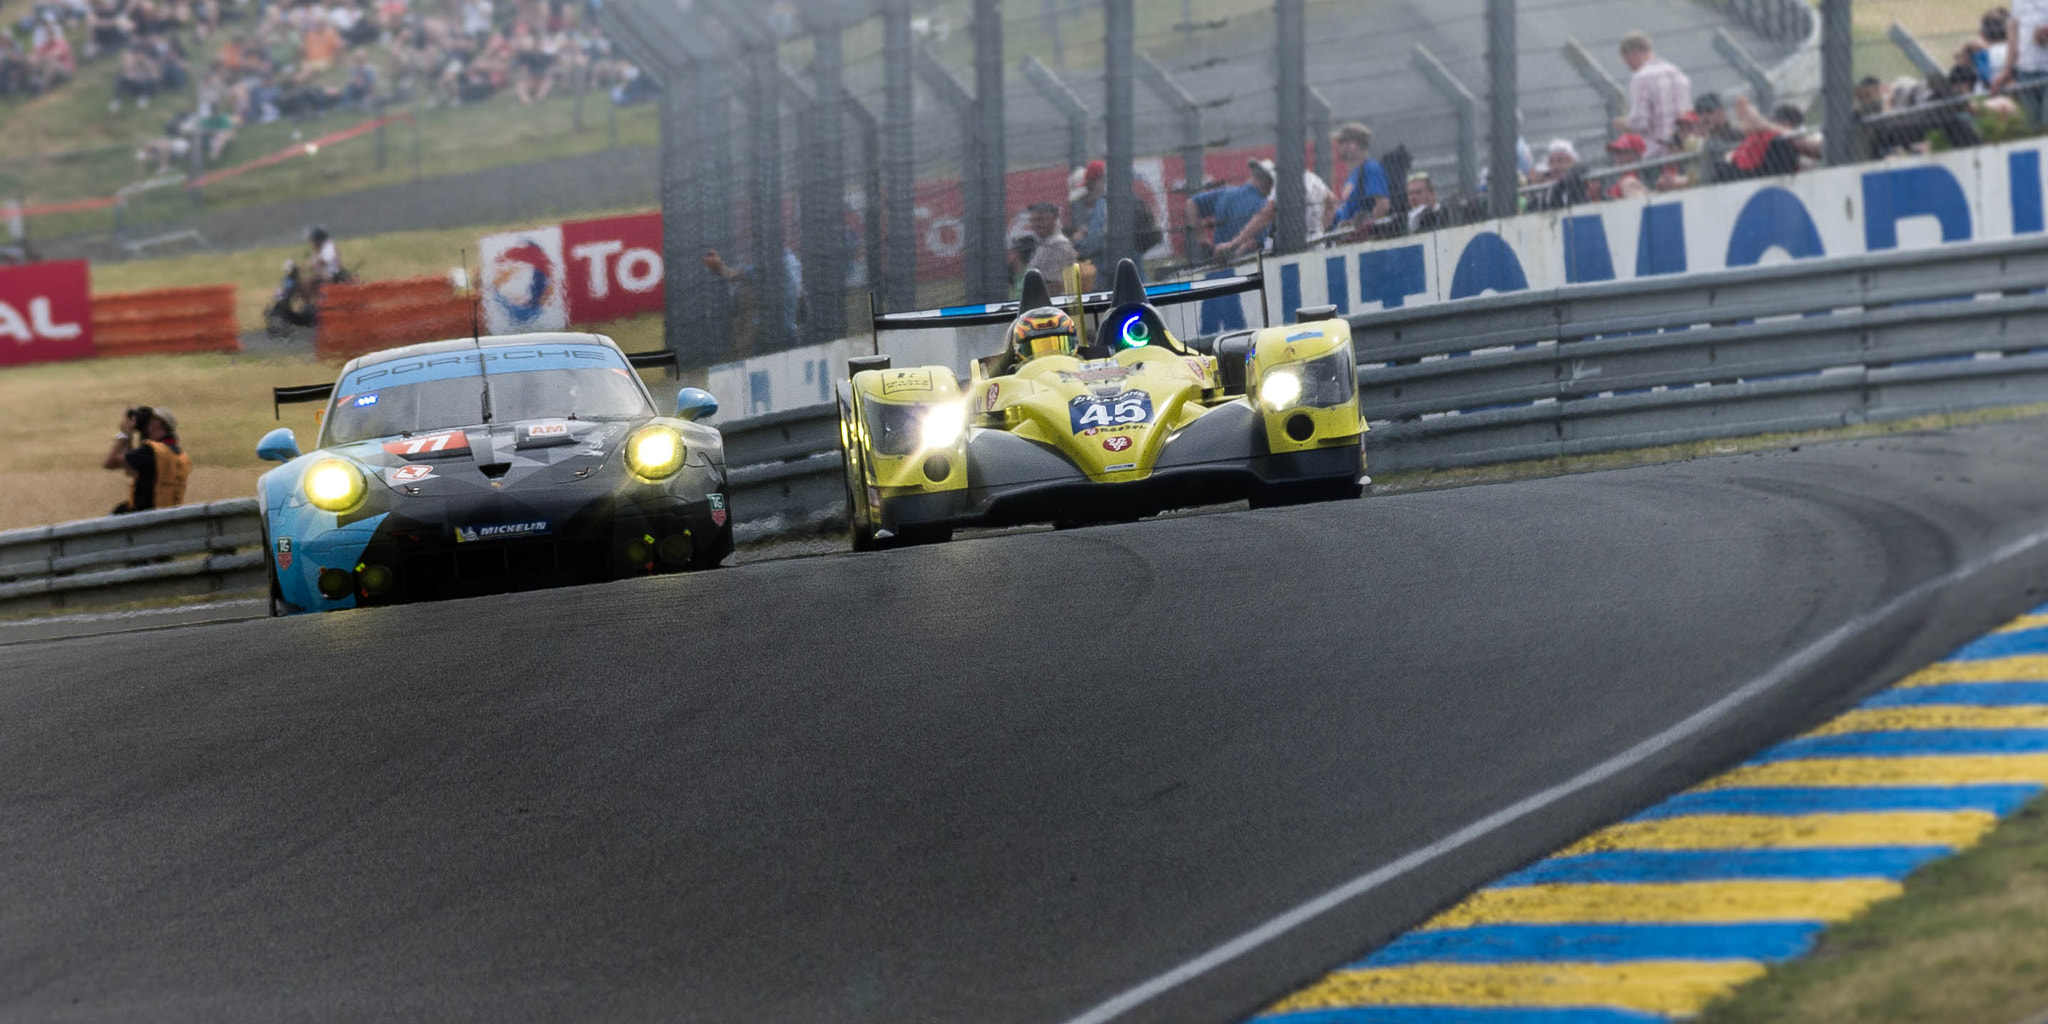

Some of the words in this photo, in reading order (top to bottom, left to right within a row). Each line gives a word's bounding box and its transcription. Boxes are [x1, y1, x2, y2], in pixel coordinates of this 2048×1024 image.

[356, 350, 606, 386] PORSCHE
[1079, 399, 1147, 425] 45
[531, 425, 564, 435] AM
[402, 434, 452, 455] 77
[480, 521, 547, 536] MICHELIN
